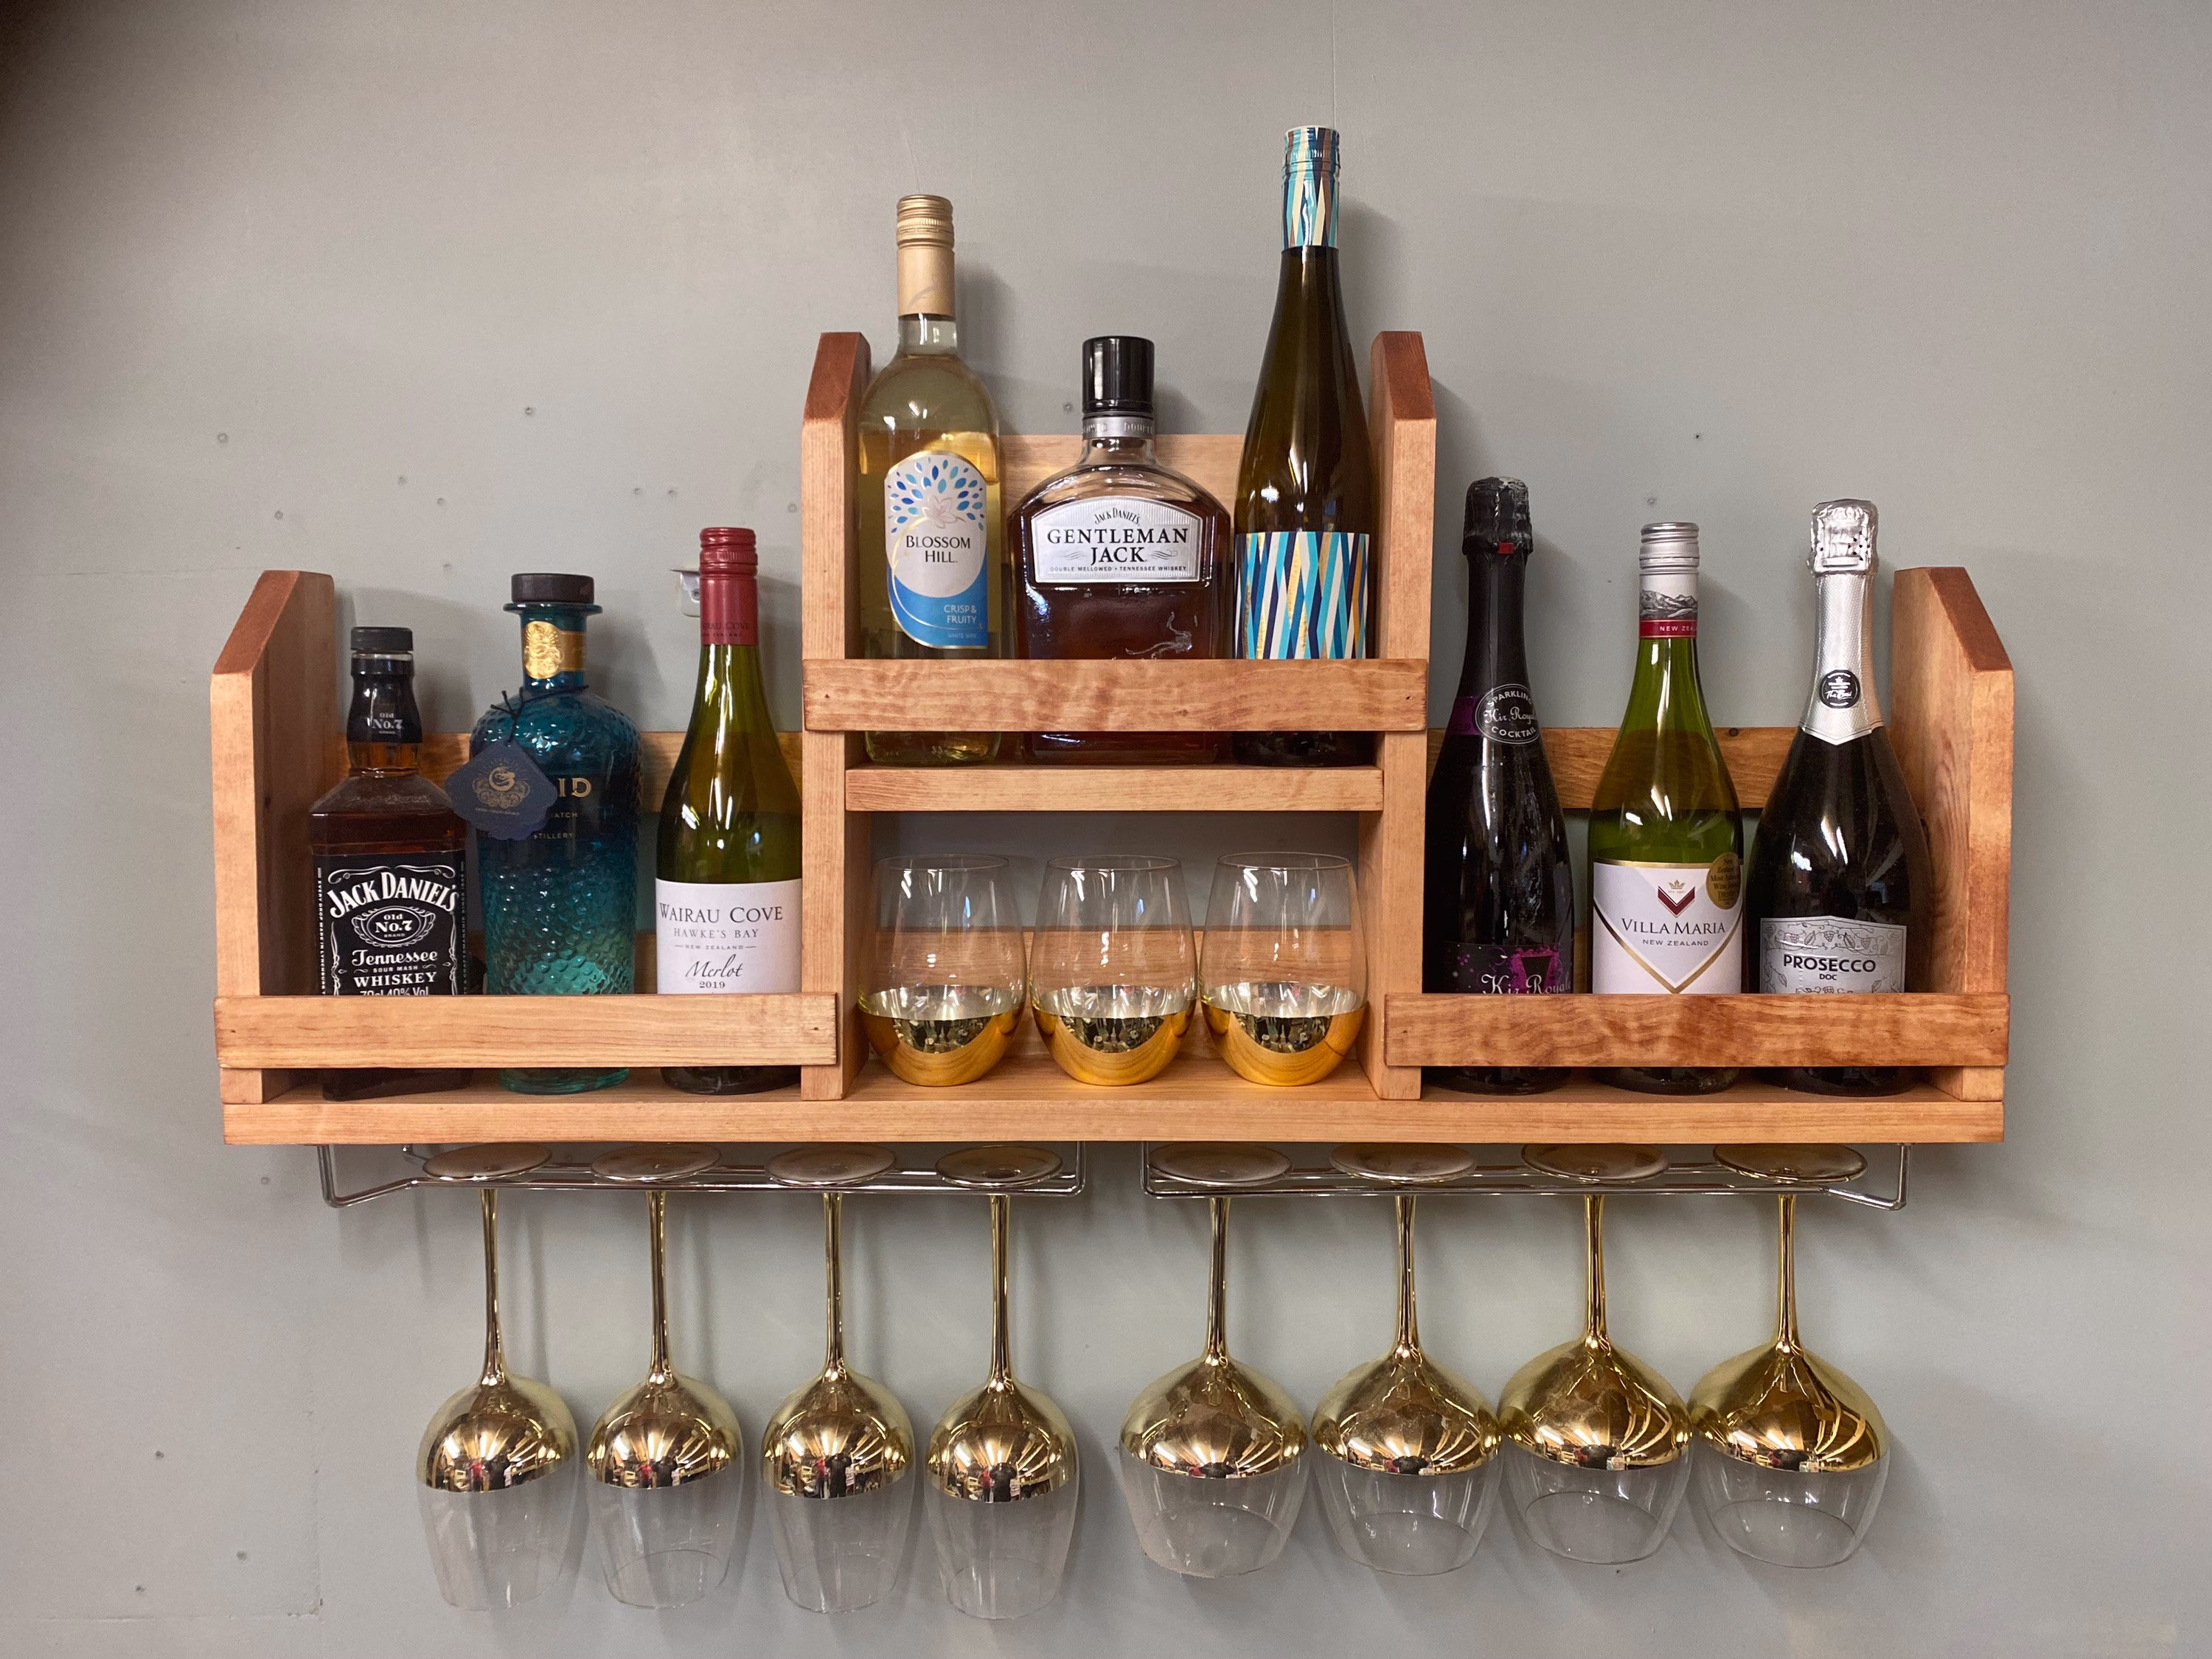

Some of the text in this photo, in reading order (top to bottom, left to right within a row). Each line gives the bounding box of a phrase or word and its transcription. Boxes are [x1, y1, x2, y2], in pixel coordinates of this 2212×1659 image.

[1094, 507, 1141, 525] JACK DANIEL'S
[906, 535, 970, 549] BLOSSOM
[1047, 528, 1189, 544] GENTLEMAN
[925, 551, 956, 563] HILL
[1091, 547, 1146, 566] JACK
[947, 616, 976, 624] FRUITY
[372, 719, 403, 729] No.7
[1492, 726, 1537, 738] COCKTAIL
[327, 872, 459, 918] JACK DANIEL'S
[660, 902, 783, 922] WAIRAU COVE
[375, 920, 413, 933] No.7
[673, 928, 759, 939] HAWKE'S BAY
[1621, 918, 1725, 934] VILLA MARIA
[351, 950, 438, 967] Tennessee
[685, 953, 744, 978] Merlot
[1784, 954, 1876, 973] PROSECCO
[353, 971, 437, 988] WHISKEY
[699, 981, 726, 989] 2019
